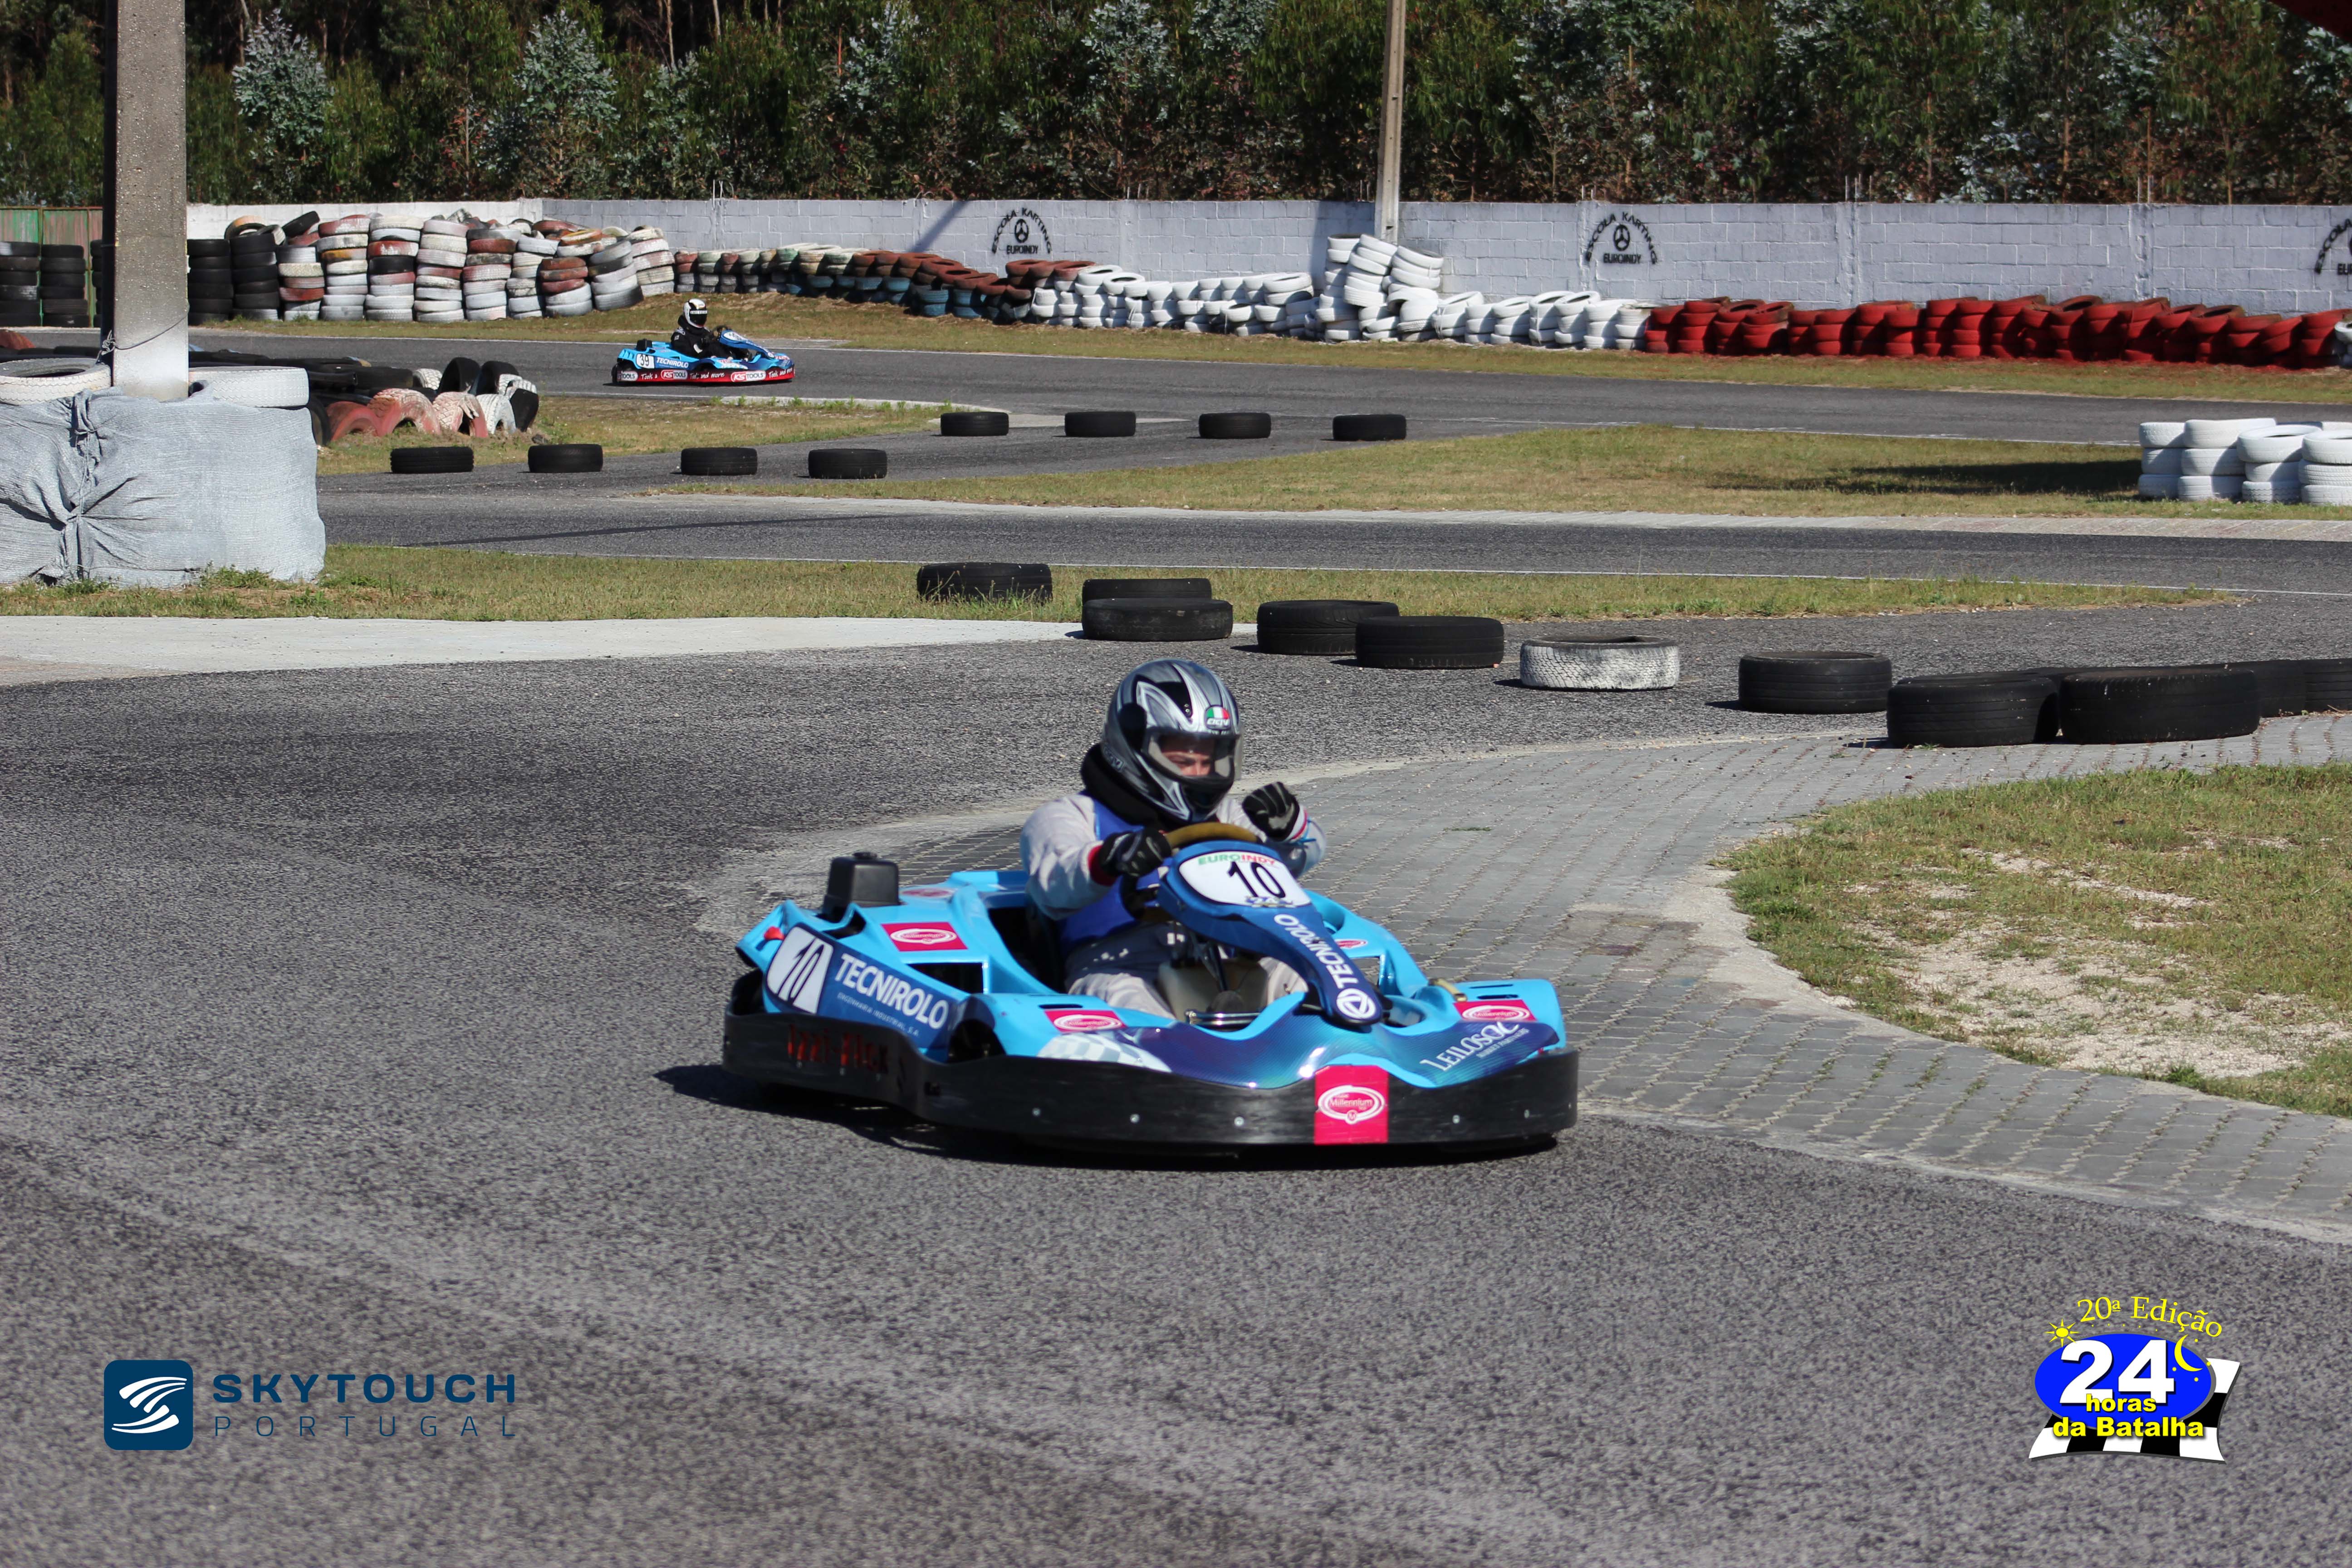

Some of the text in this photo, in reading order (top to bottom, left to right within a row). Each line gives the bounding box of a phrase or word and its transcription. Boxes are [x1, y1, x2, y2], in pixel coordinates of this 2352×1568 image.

[1006, 245, 1039, 255] EUROINDY
[1603, 253, 1642, 264] EUROINDY
[640, 354, 650, 367] 39
[657, 357, 689, 368] TECNIROLO
[1227, 861, 1286, 898] 10
[777, 937, 824, 1004] 10
[834, 953, 949, 1029] TECNIROLO
[1329, 1098, 1373, 1107] Millennium
